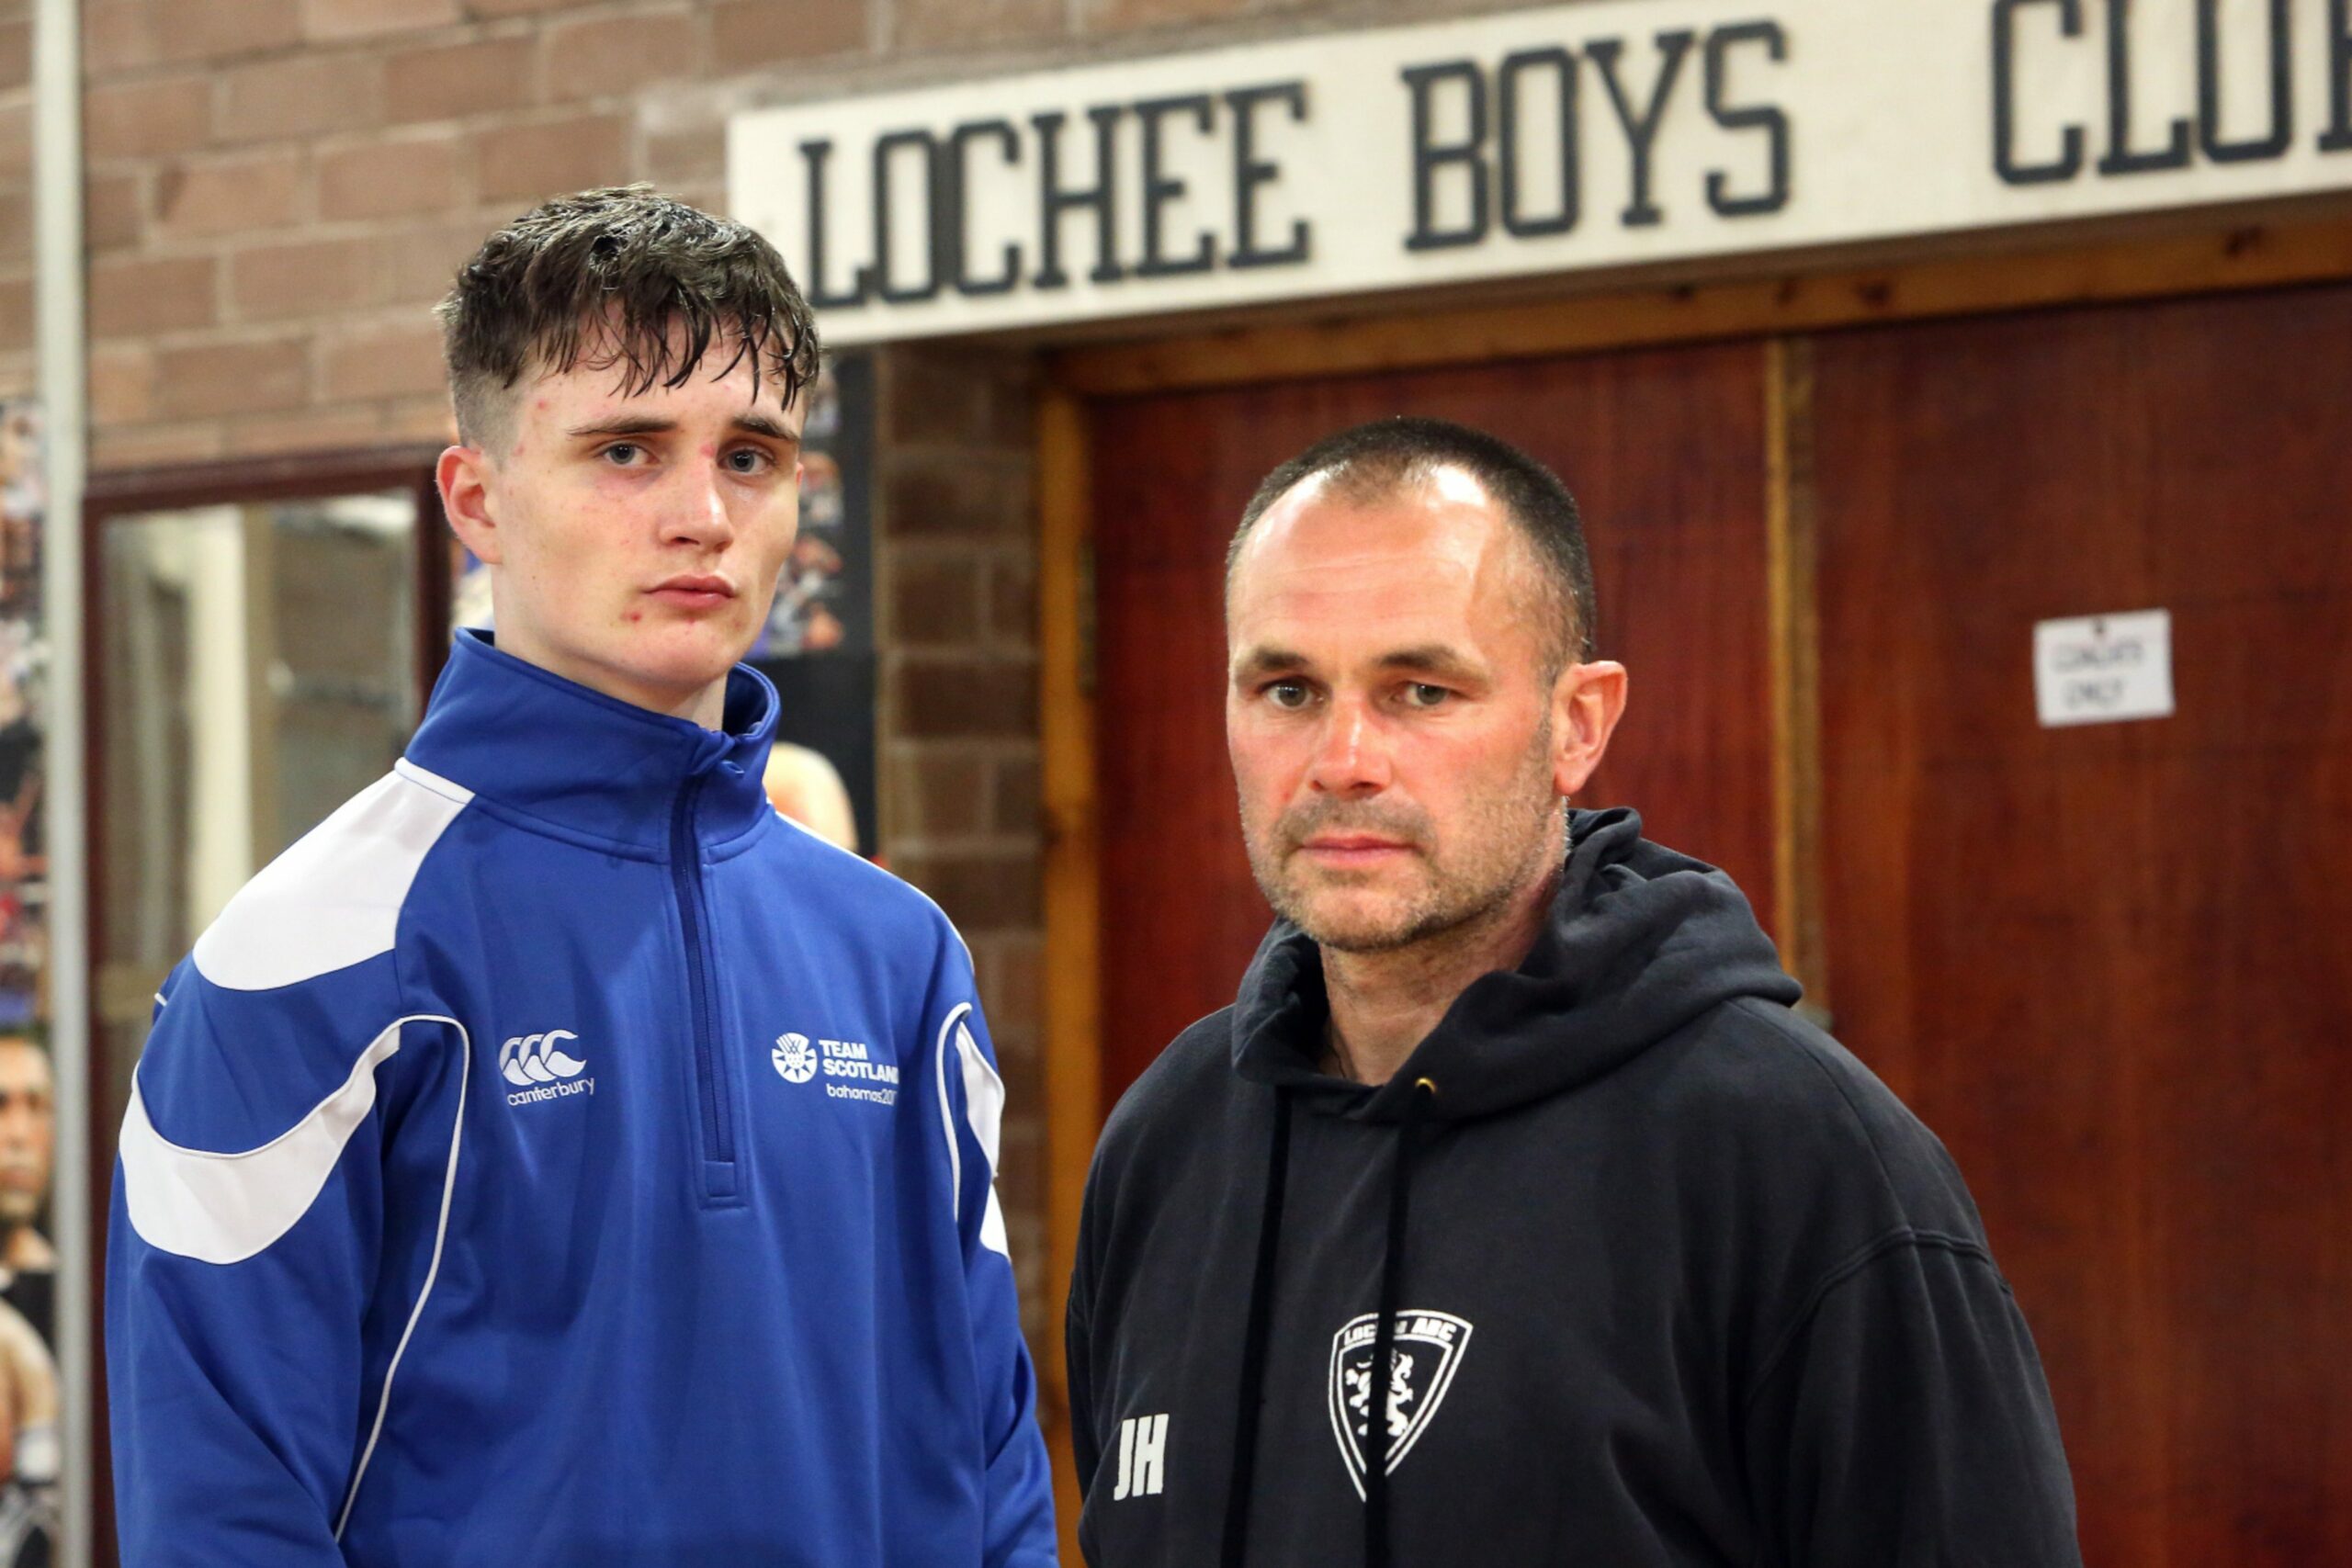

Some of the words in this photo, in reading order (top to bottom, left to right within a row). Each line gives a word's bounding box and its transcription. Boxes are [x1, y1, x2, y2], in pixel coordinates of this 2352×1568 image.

[797, 78, 1312, 309] LOCHEE
[1400, 19, 1791, 254] BOYS
[818, 1039, 868, 1060] TEAM
[822, 1058, 899, 1085] SCOTLAN
[506, 1077, 595, 1107] canterbury
[1113, 1413, 1170, 1502] JH
